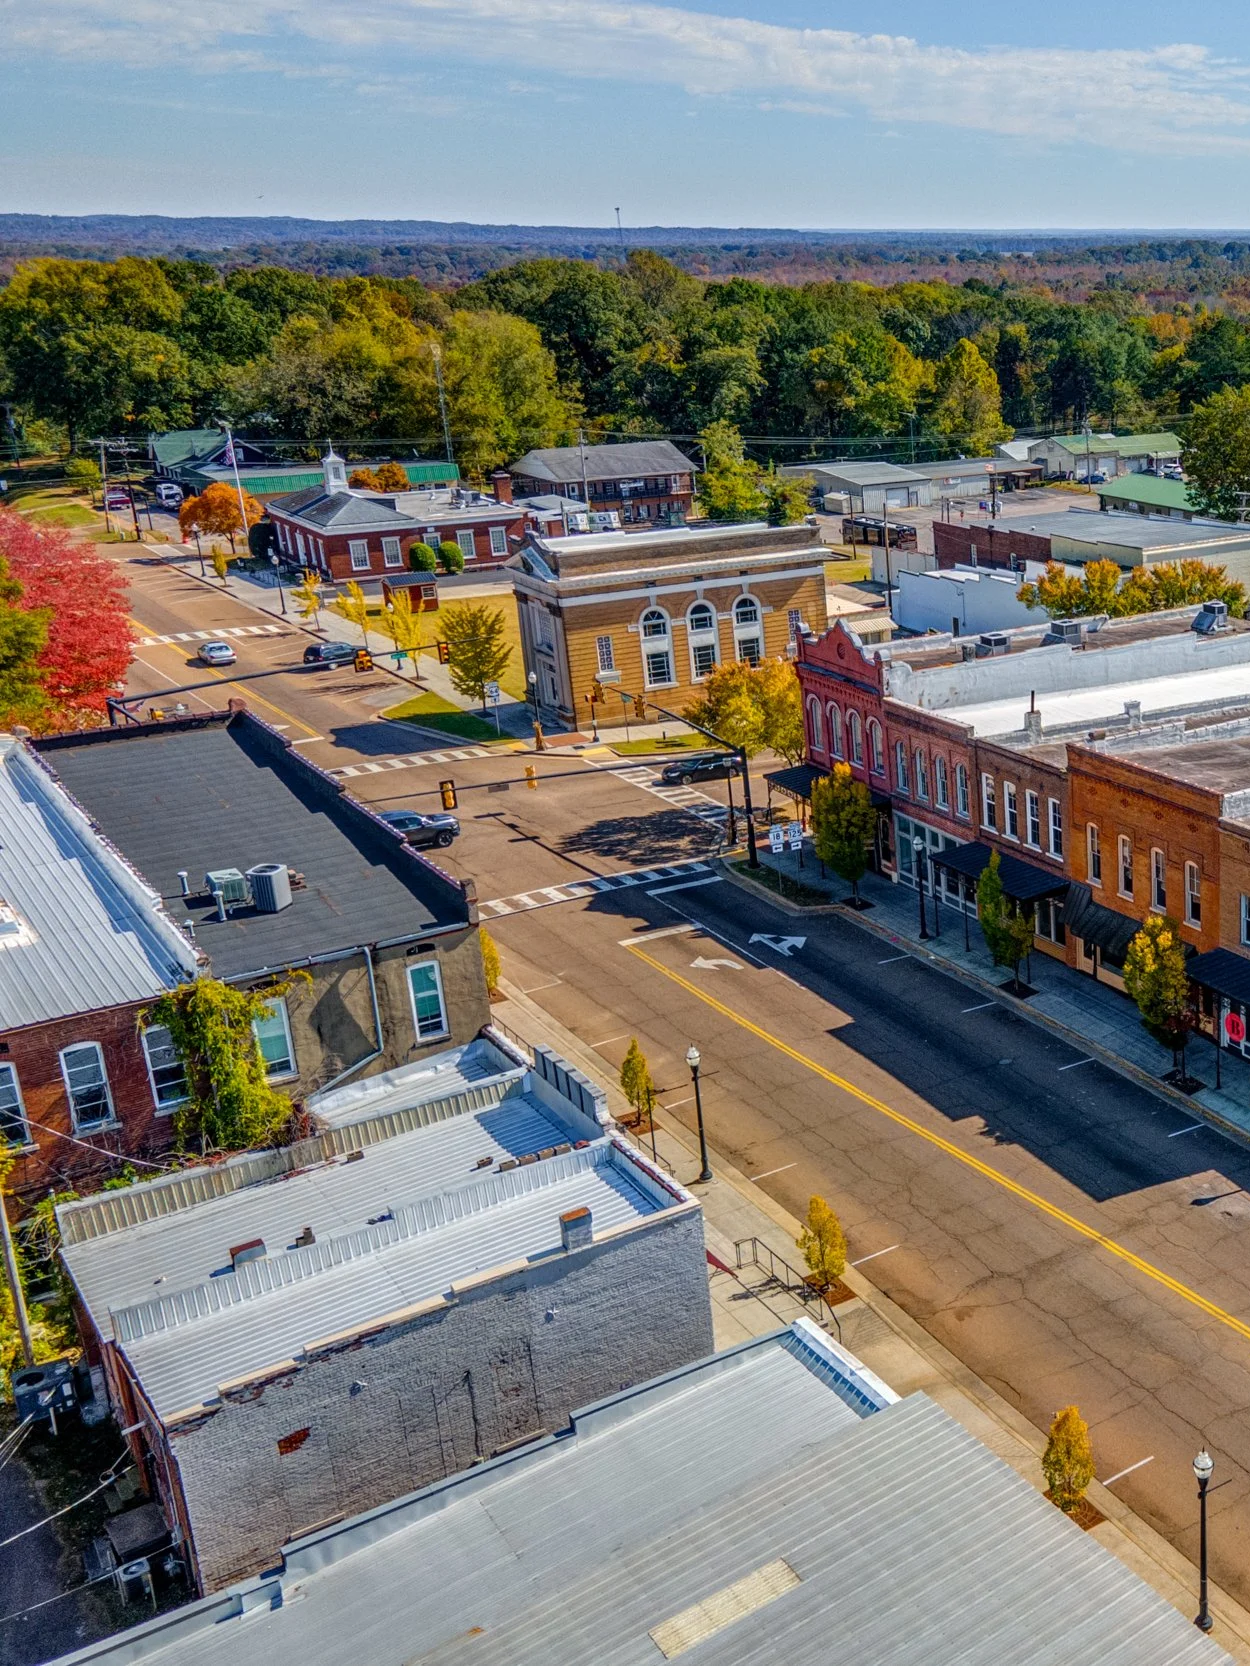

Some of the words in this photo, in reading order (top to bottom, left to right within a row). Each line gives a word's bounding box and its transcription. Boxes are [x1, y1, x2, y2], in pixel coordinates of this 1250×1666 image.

[772, 832, 781, 841] 18
[789, 830, 802, 839] 125
[1231, 1018, 1241, 1036] B
